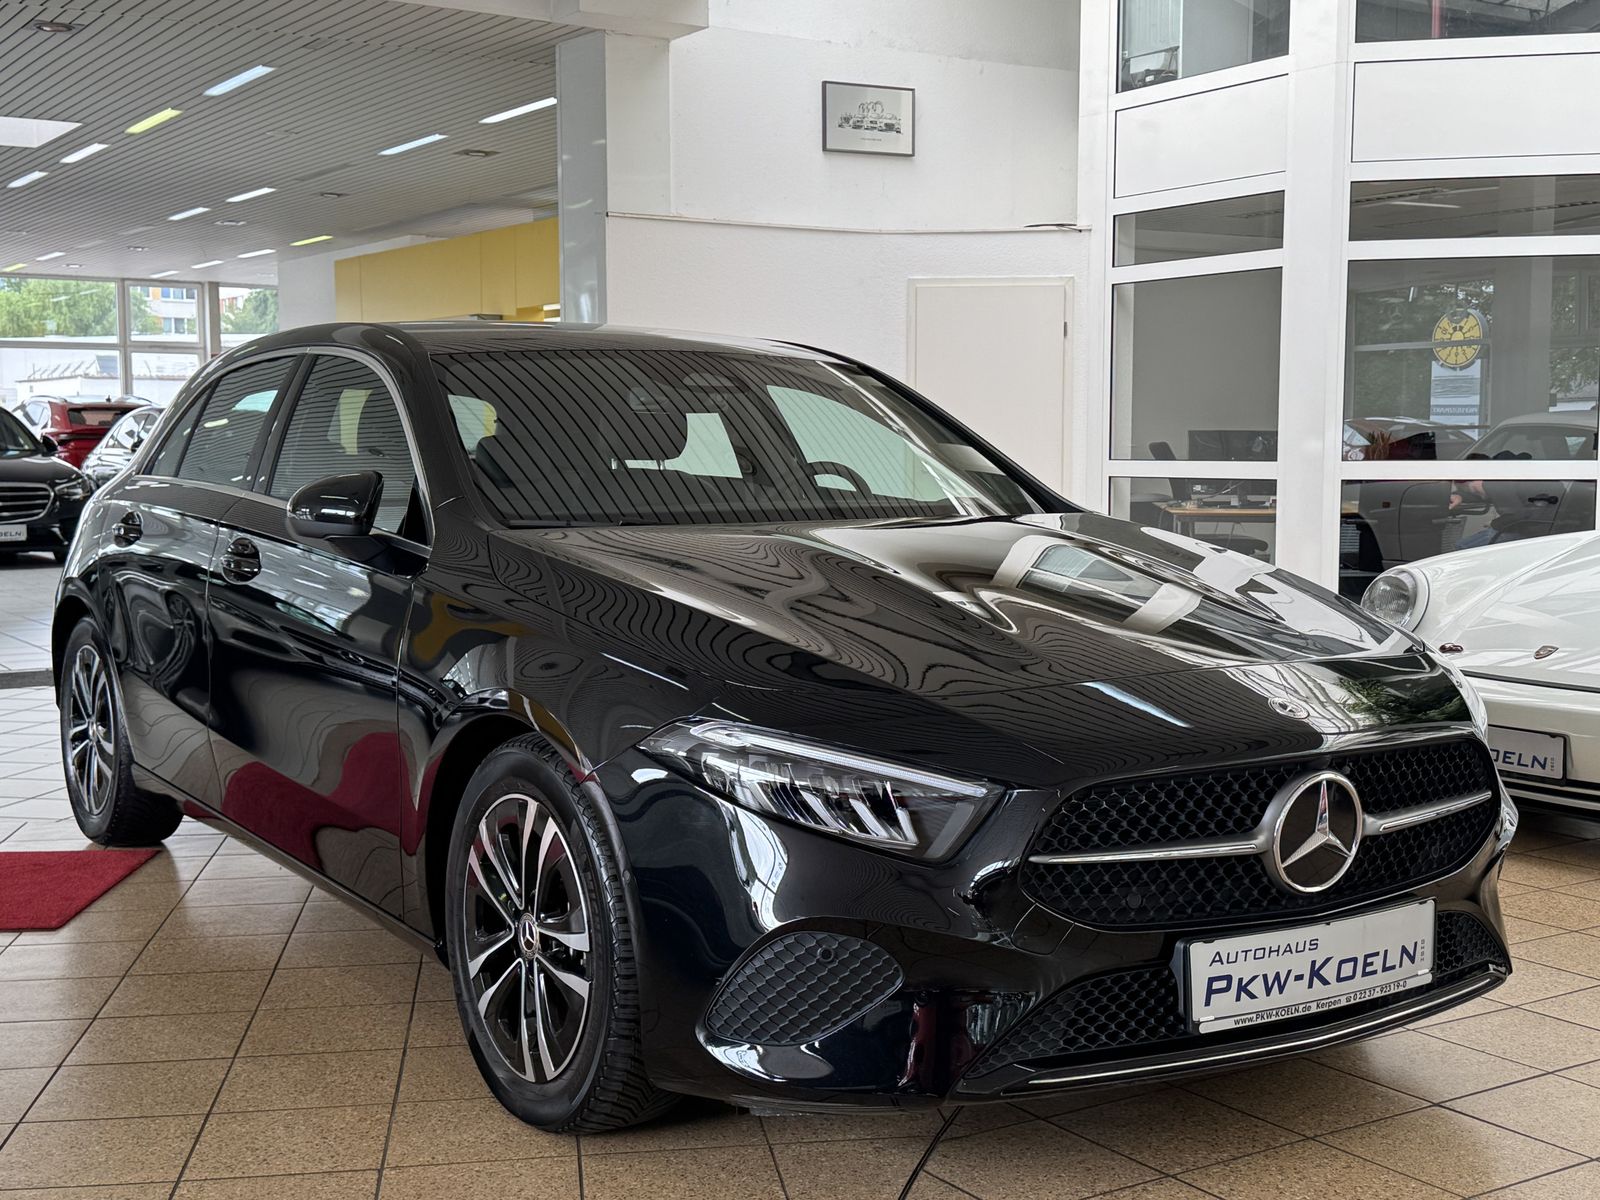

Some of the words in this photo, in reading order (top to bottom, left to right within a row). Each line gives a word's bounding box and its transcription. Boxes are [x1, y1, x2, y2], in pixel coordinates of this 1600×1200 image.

[1209, 938, 1319, 967] AUTOHAUS
[1203, 941, 1418, 1007] PKW-KOELN
[1233, 1004, 1312, 1026] www.PKW-KOELN.de
[1316, 998, 1342, 1010] Kerpen
